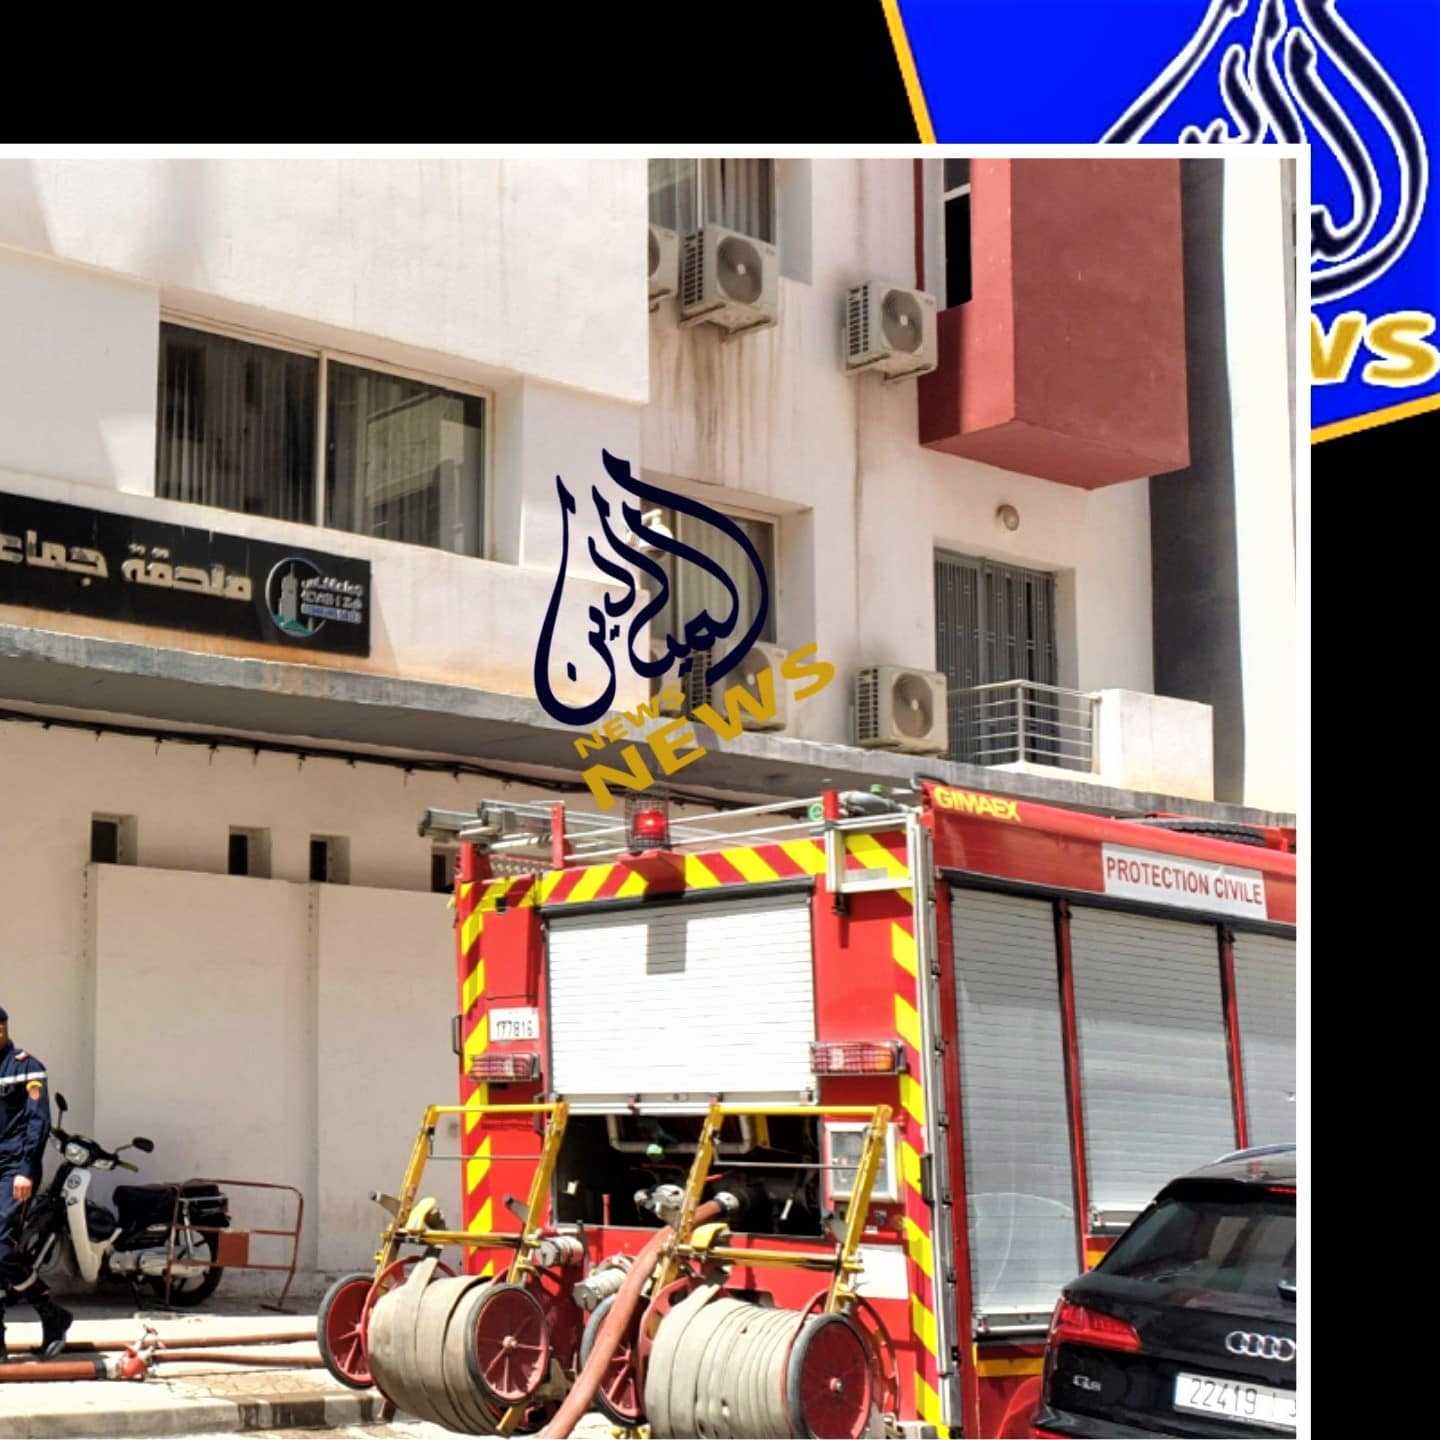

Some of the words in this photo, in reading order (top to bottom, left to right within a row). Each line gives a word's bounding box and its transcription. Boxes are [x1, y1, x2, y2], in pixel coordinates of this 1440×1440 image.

[121, 543, 253, 601] ملحقة
[933, 784, 1022, 823] GIMAEX
[1106, 856, 1210, 897] PROTECTION
[1213, 879, 1263, 906] CIVILE
[1188, 1375, 1258, 1417] 22419
